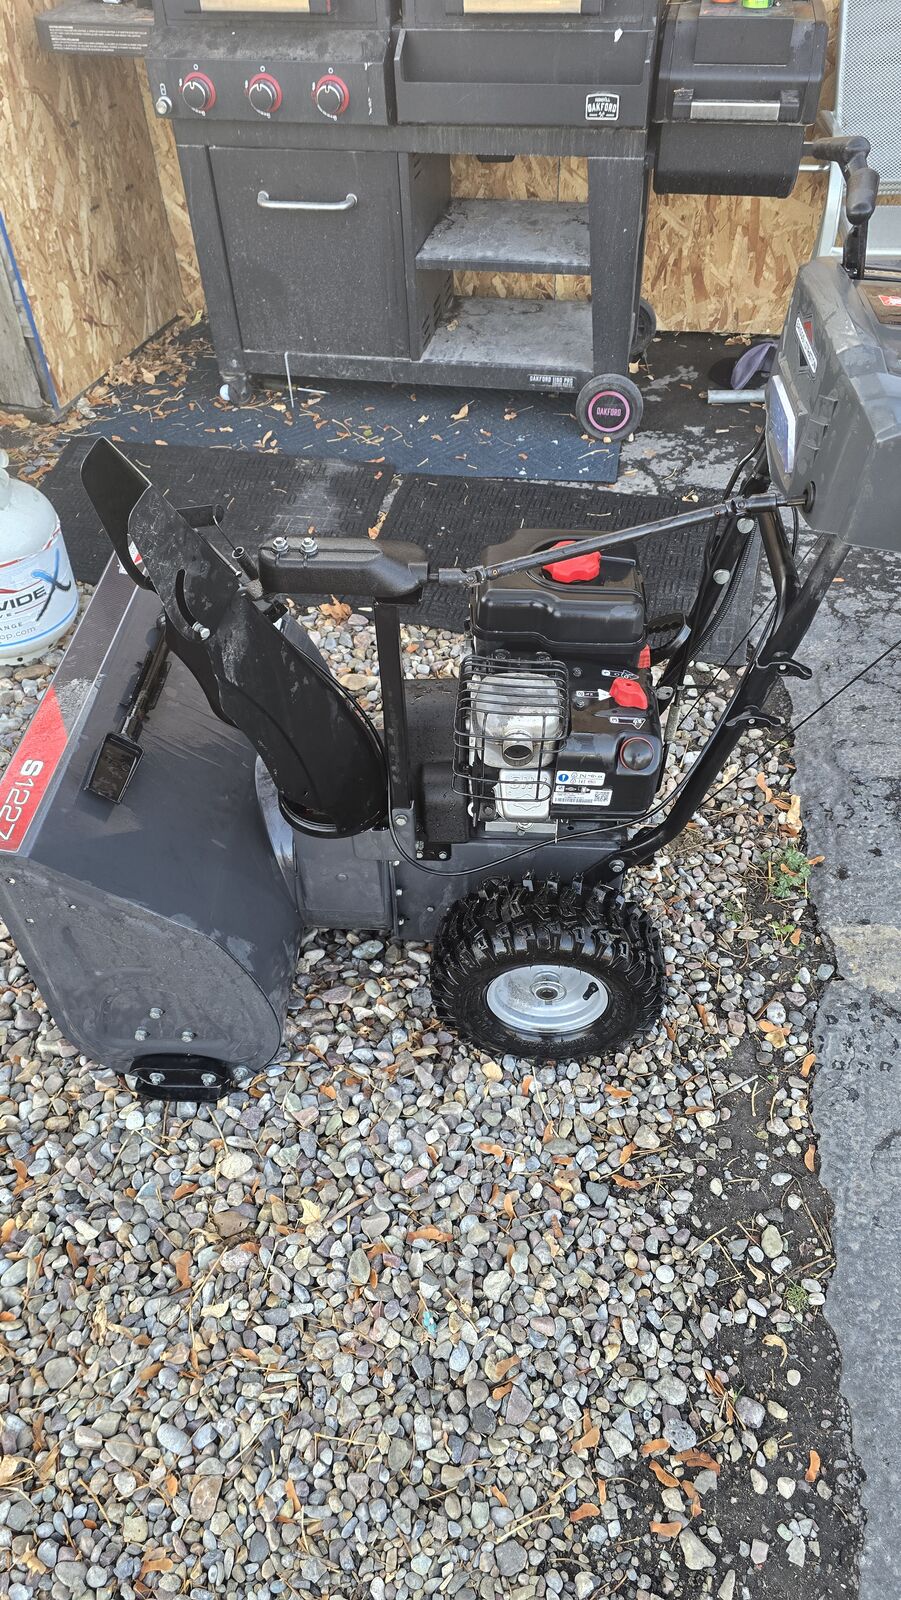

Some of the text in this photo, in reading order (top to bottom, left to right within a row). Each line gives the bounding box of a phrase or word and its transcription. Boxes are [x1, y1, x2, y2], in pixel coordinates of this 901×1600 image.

[588, 103, 617, 113] OAKFORD
[529, 375, 551, 383] OAKFORD
[596, 406, 621, 417] OAKFORD
[0, 759, 44, 840] S1227
